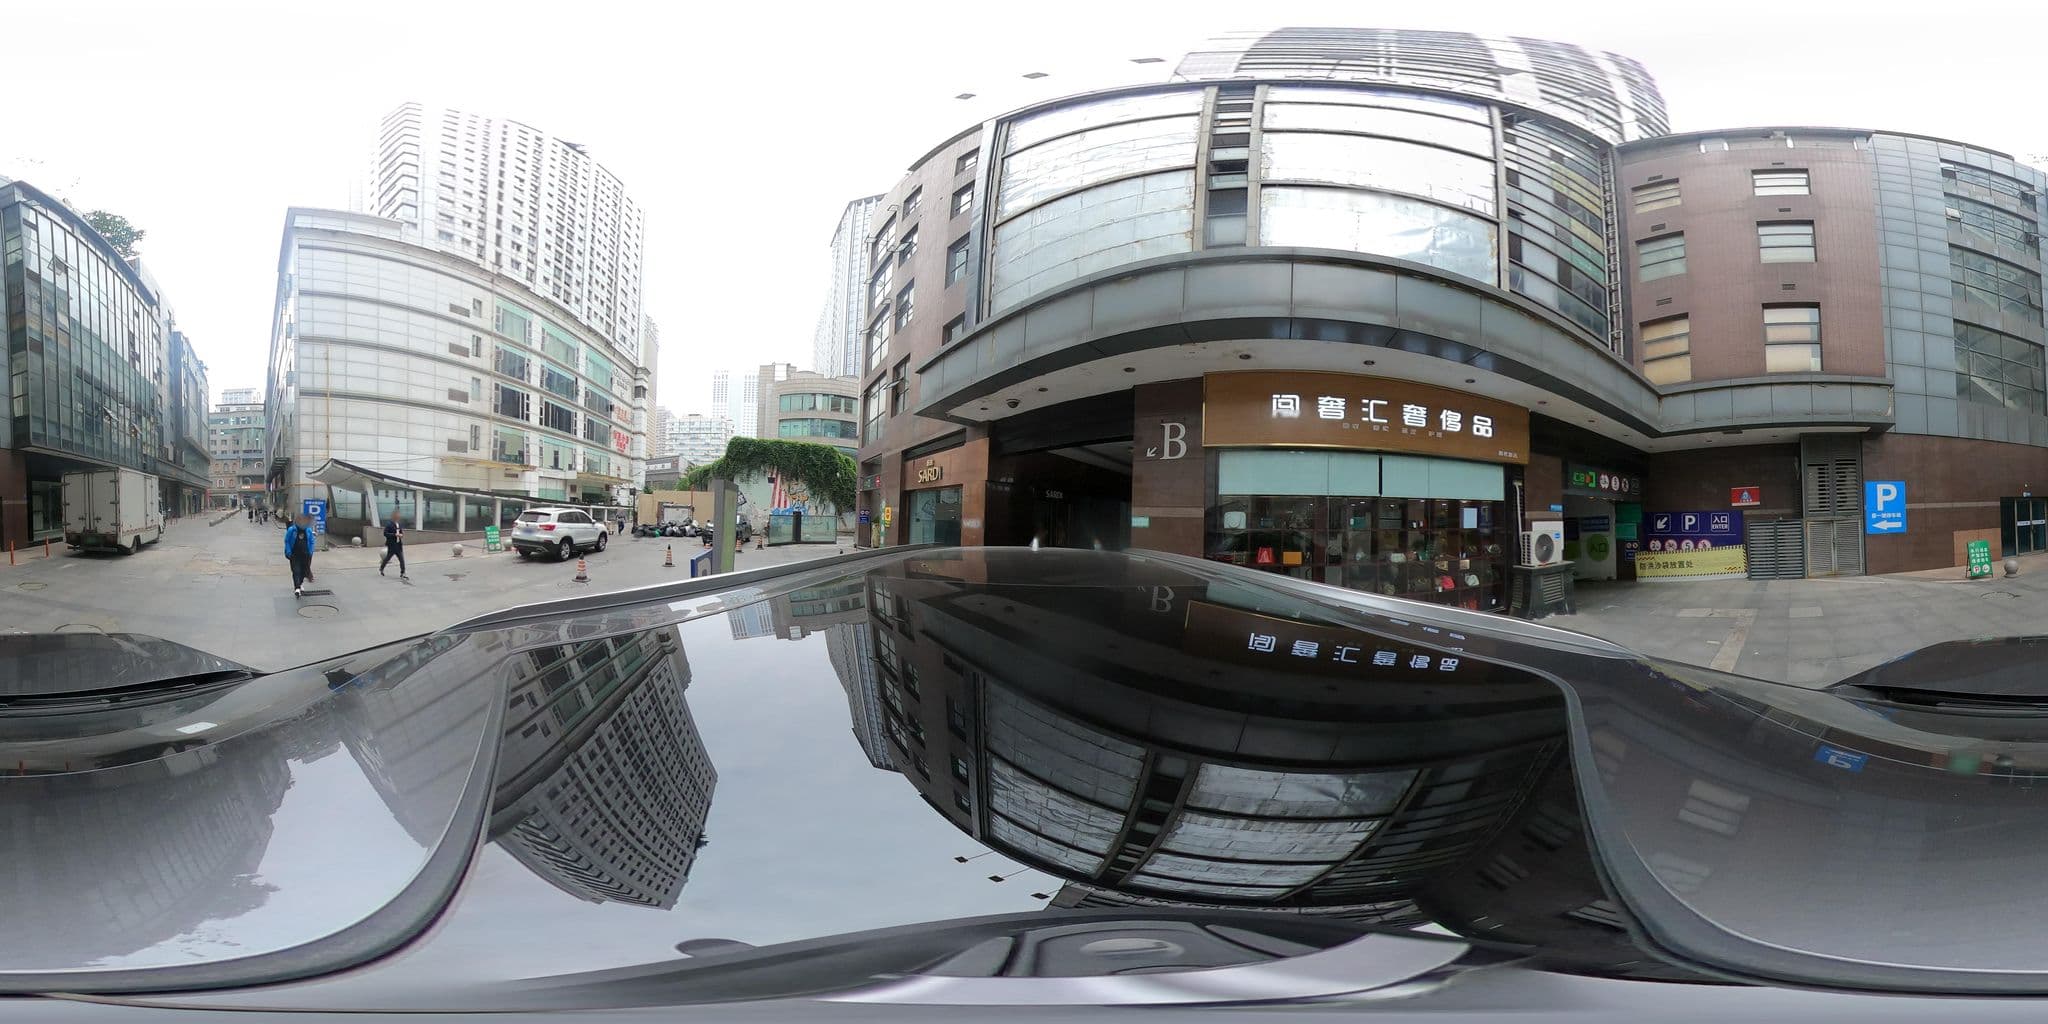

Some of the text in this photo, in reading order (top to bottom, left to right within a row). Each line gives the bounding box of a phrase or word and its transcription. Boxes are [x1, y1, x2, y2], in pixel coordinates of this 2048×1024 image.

[1271, 394, 1495, 438] 问奢汇奢侈品
[1160, 422, 1187, 460] B
[917, 465, 942, 483] SARDI
[1877, 484, 1897, 511] P
[1684, 515, 1696, 530] P
[1713, 515, 1728, 523] 入口
